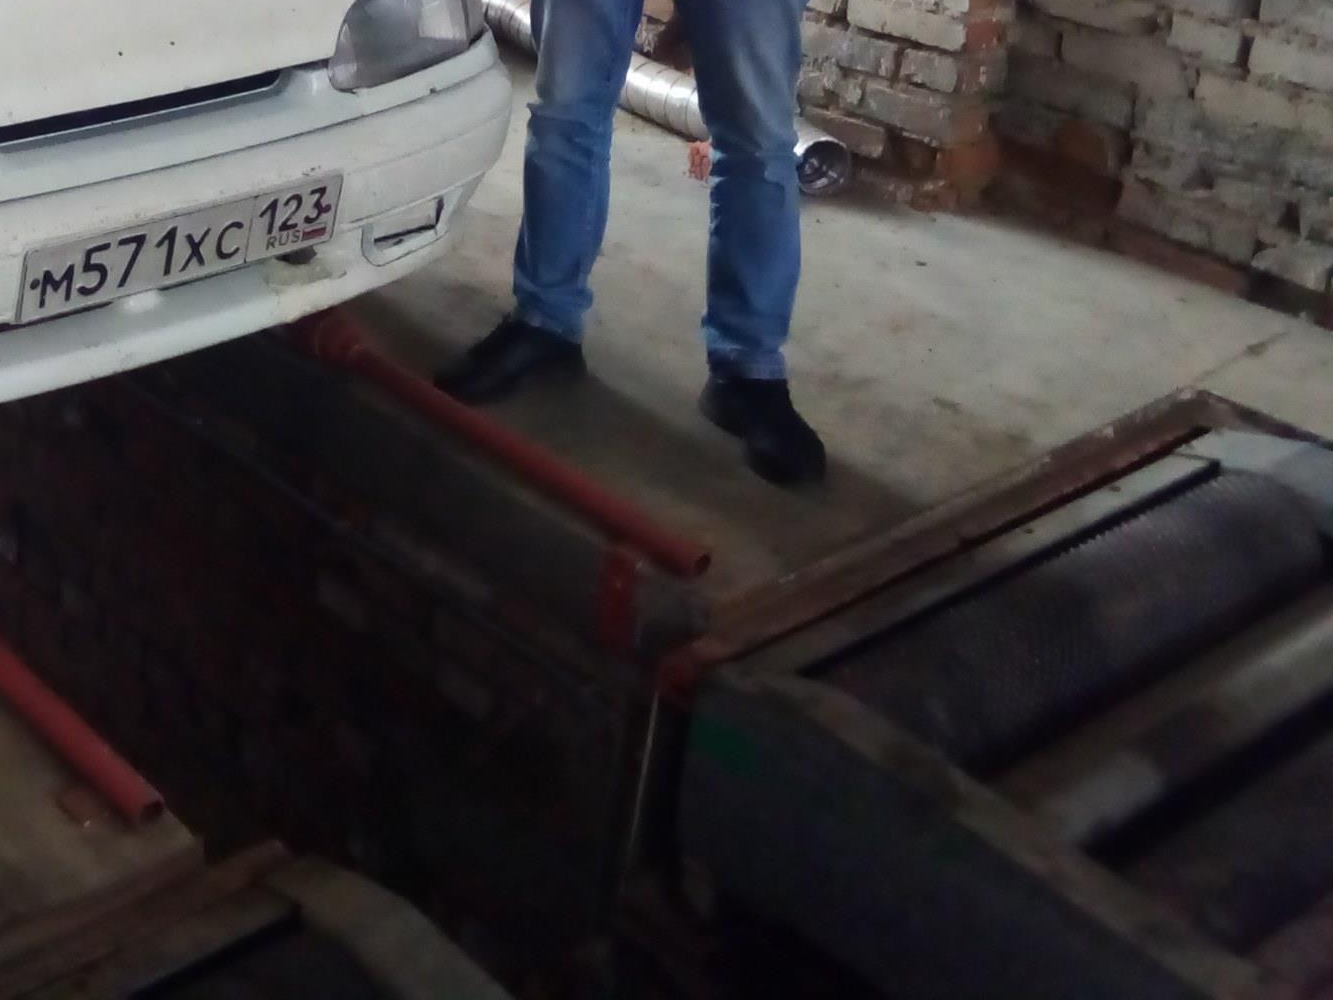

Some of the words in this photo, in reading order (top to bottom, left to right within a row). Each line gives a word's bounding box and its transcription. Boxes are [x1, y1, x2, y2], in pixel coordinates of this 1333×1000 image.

[38, 221, 244, 309] М571ХС
[259, 186, 329, 235] 123
[265, 229, 301, 250] RUS
